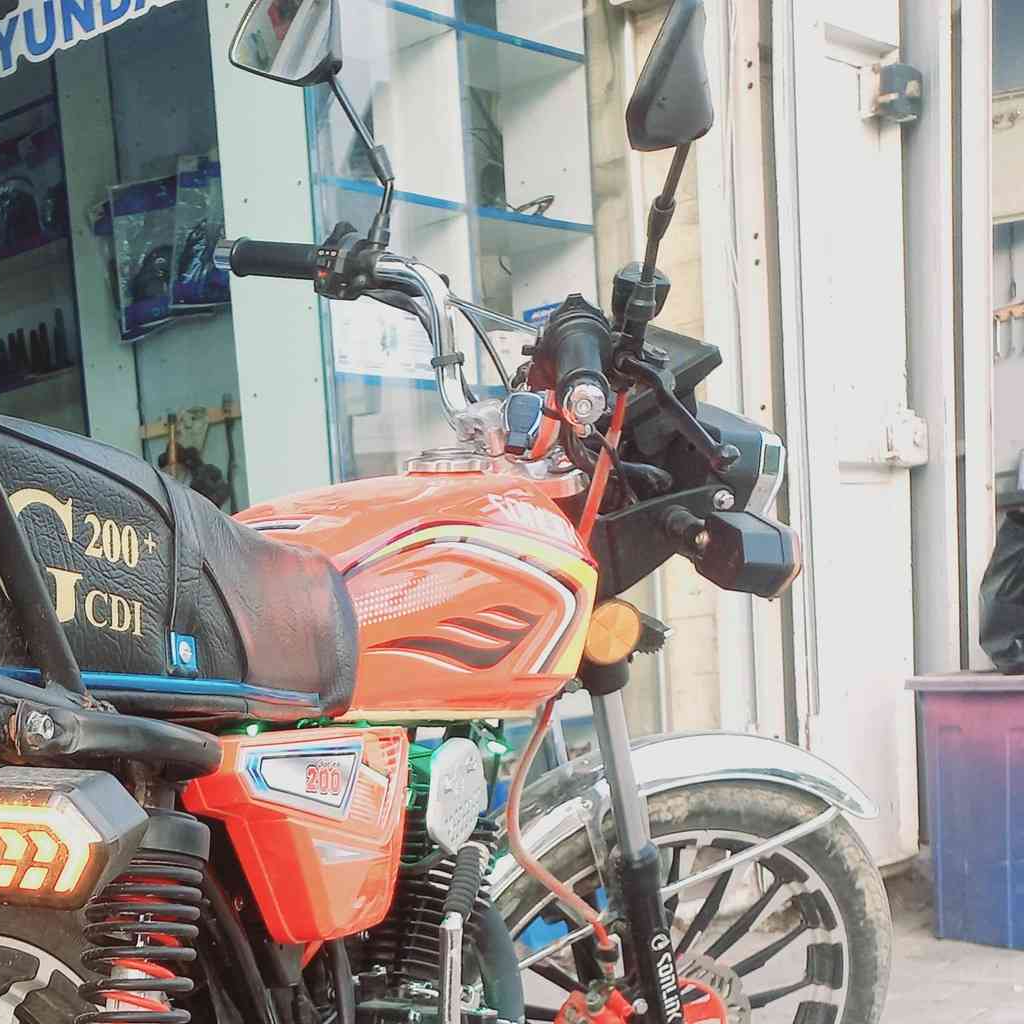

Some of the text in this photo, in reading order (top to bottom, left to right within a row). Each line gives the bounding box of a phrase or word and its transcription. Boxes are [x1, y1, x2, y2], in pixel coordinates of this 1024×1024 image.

[84, 589, 145, 637] CDI
[304, 763, 341, 796] 200
[655, 952, 683, 1024] SONLINK
